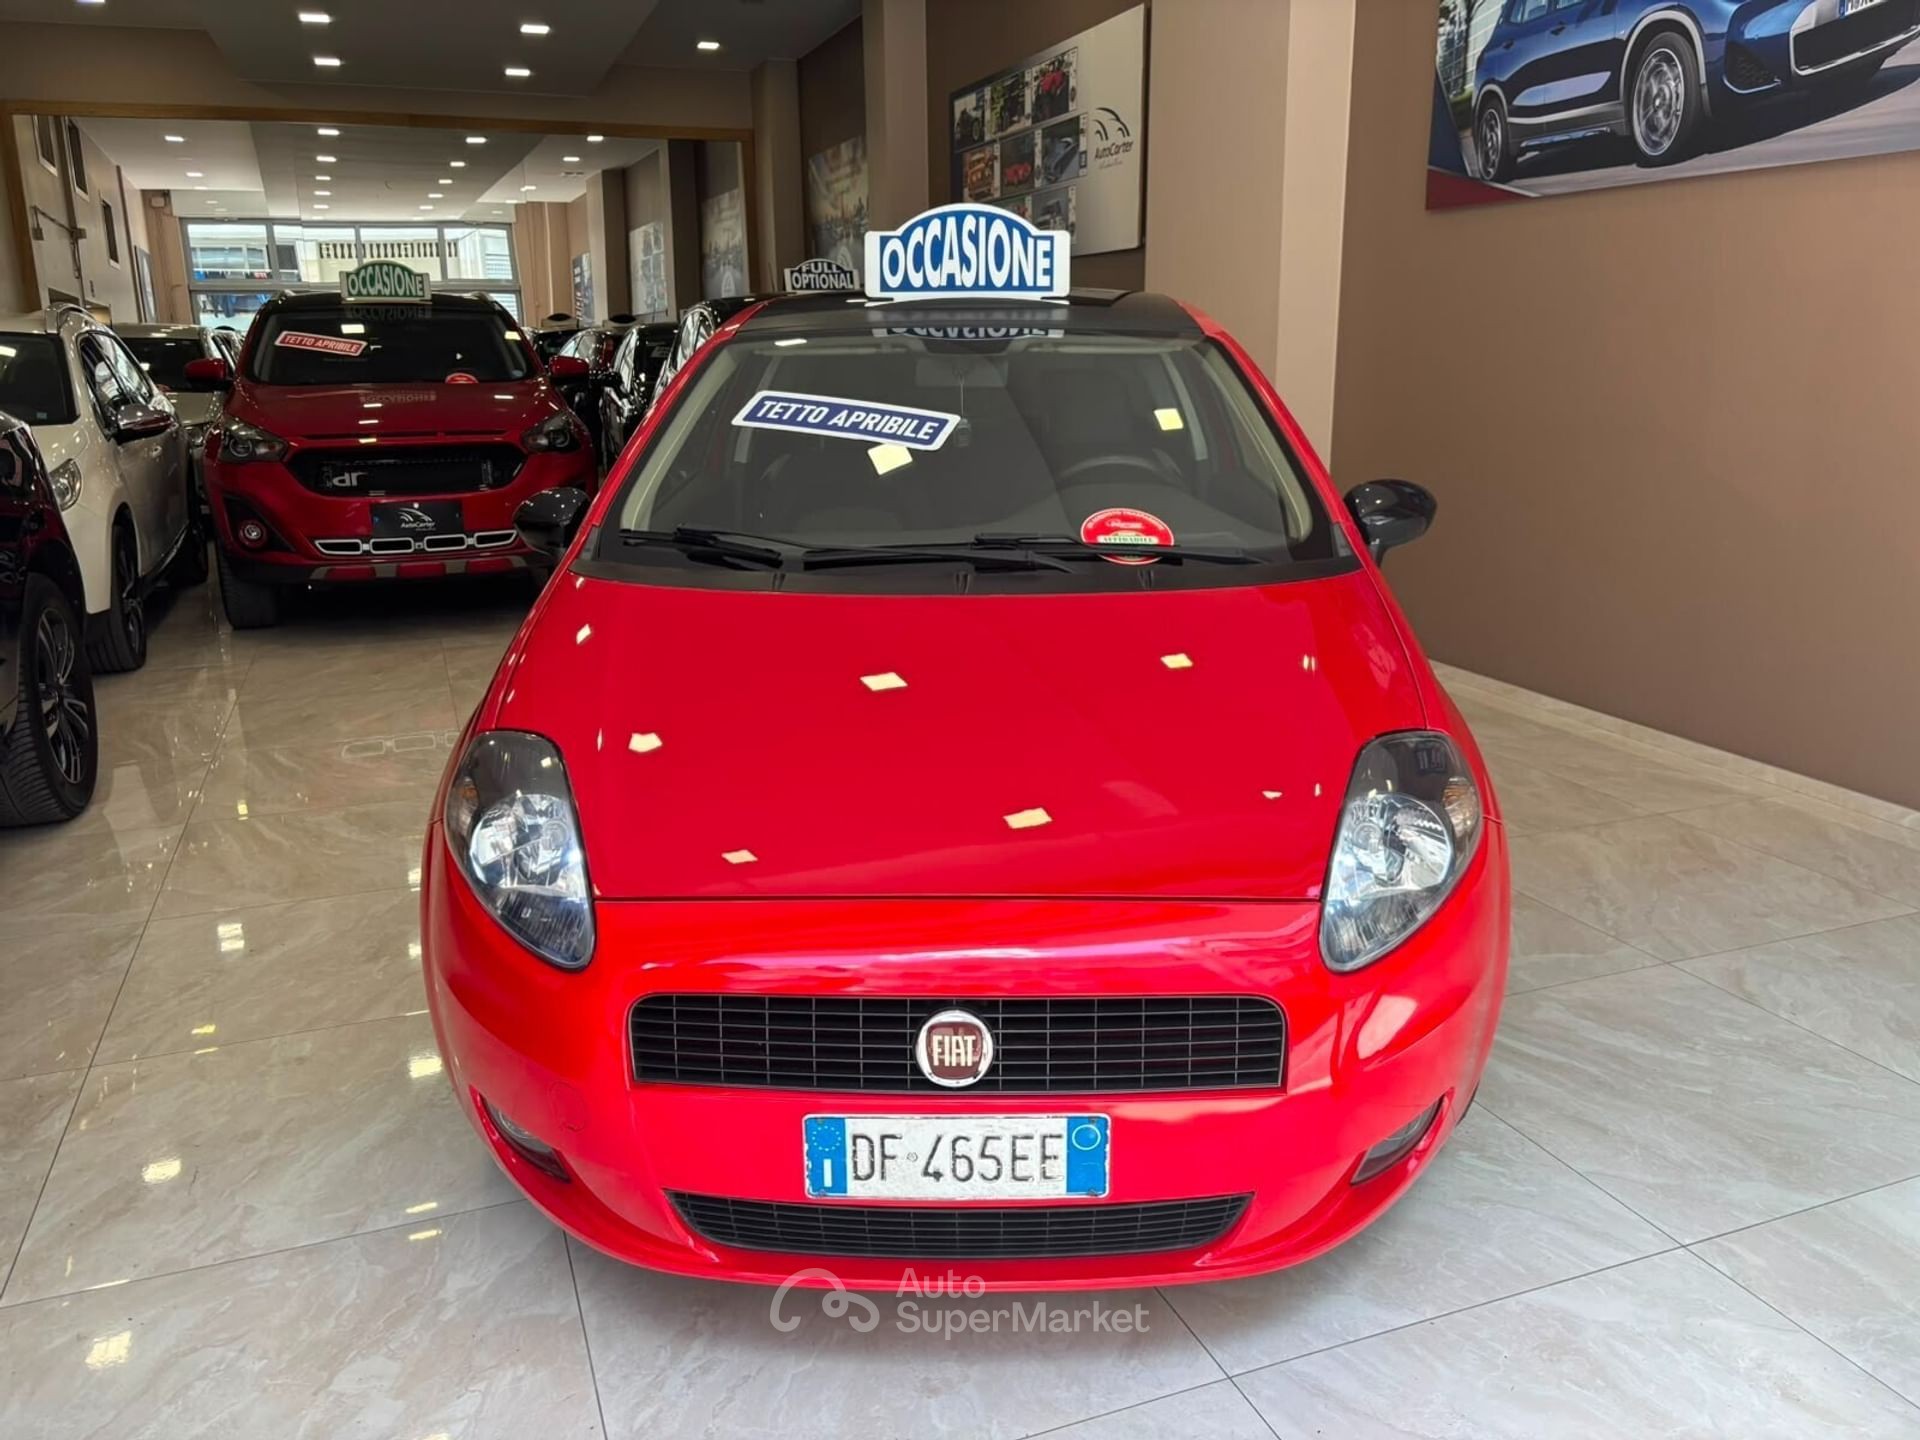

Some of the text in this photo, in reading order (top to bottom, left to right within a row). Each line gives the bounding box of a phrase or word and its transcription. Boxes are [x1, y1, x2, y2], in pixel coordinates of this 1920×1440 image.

[802, 261, 841, 273] FULL
[882, 213, 1052, 289] OCCASIONE
[348, 264, 424, 296] OCCASIONE
[792, 271, 854, 289] OPTIONAL
[283, 335, 361, 353] TETTO APRIBILE
[756, 400, 939, 440] TETTO APRIBILE
[932, 1035, 977, 1067] FIAT
[852, 1133, 1064, 1183] DF 465EE
